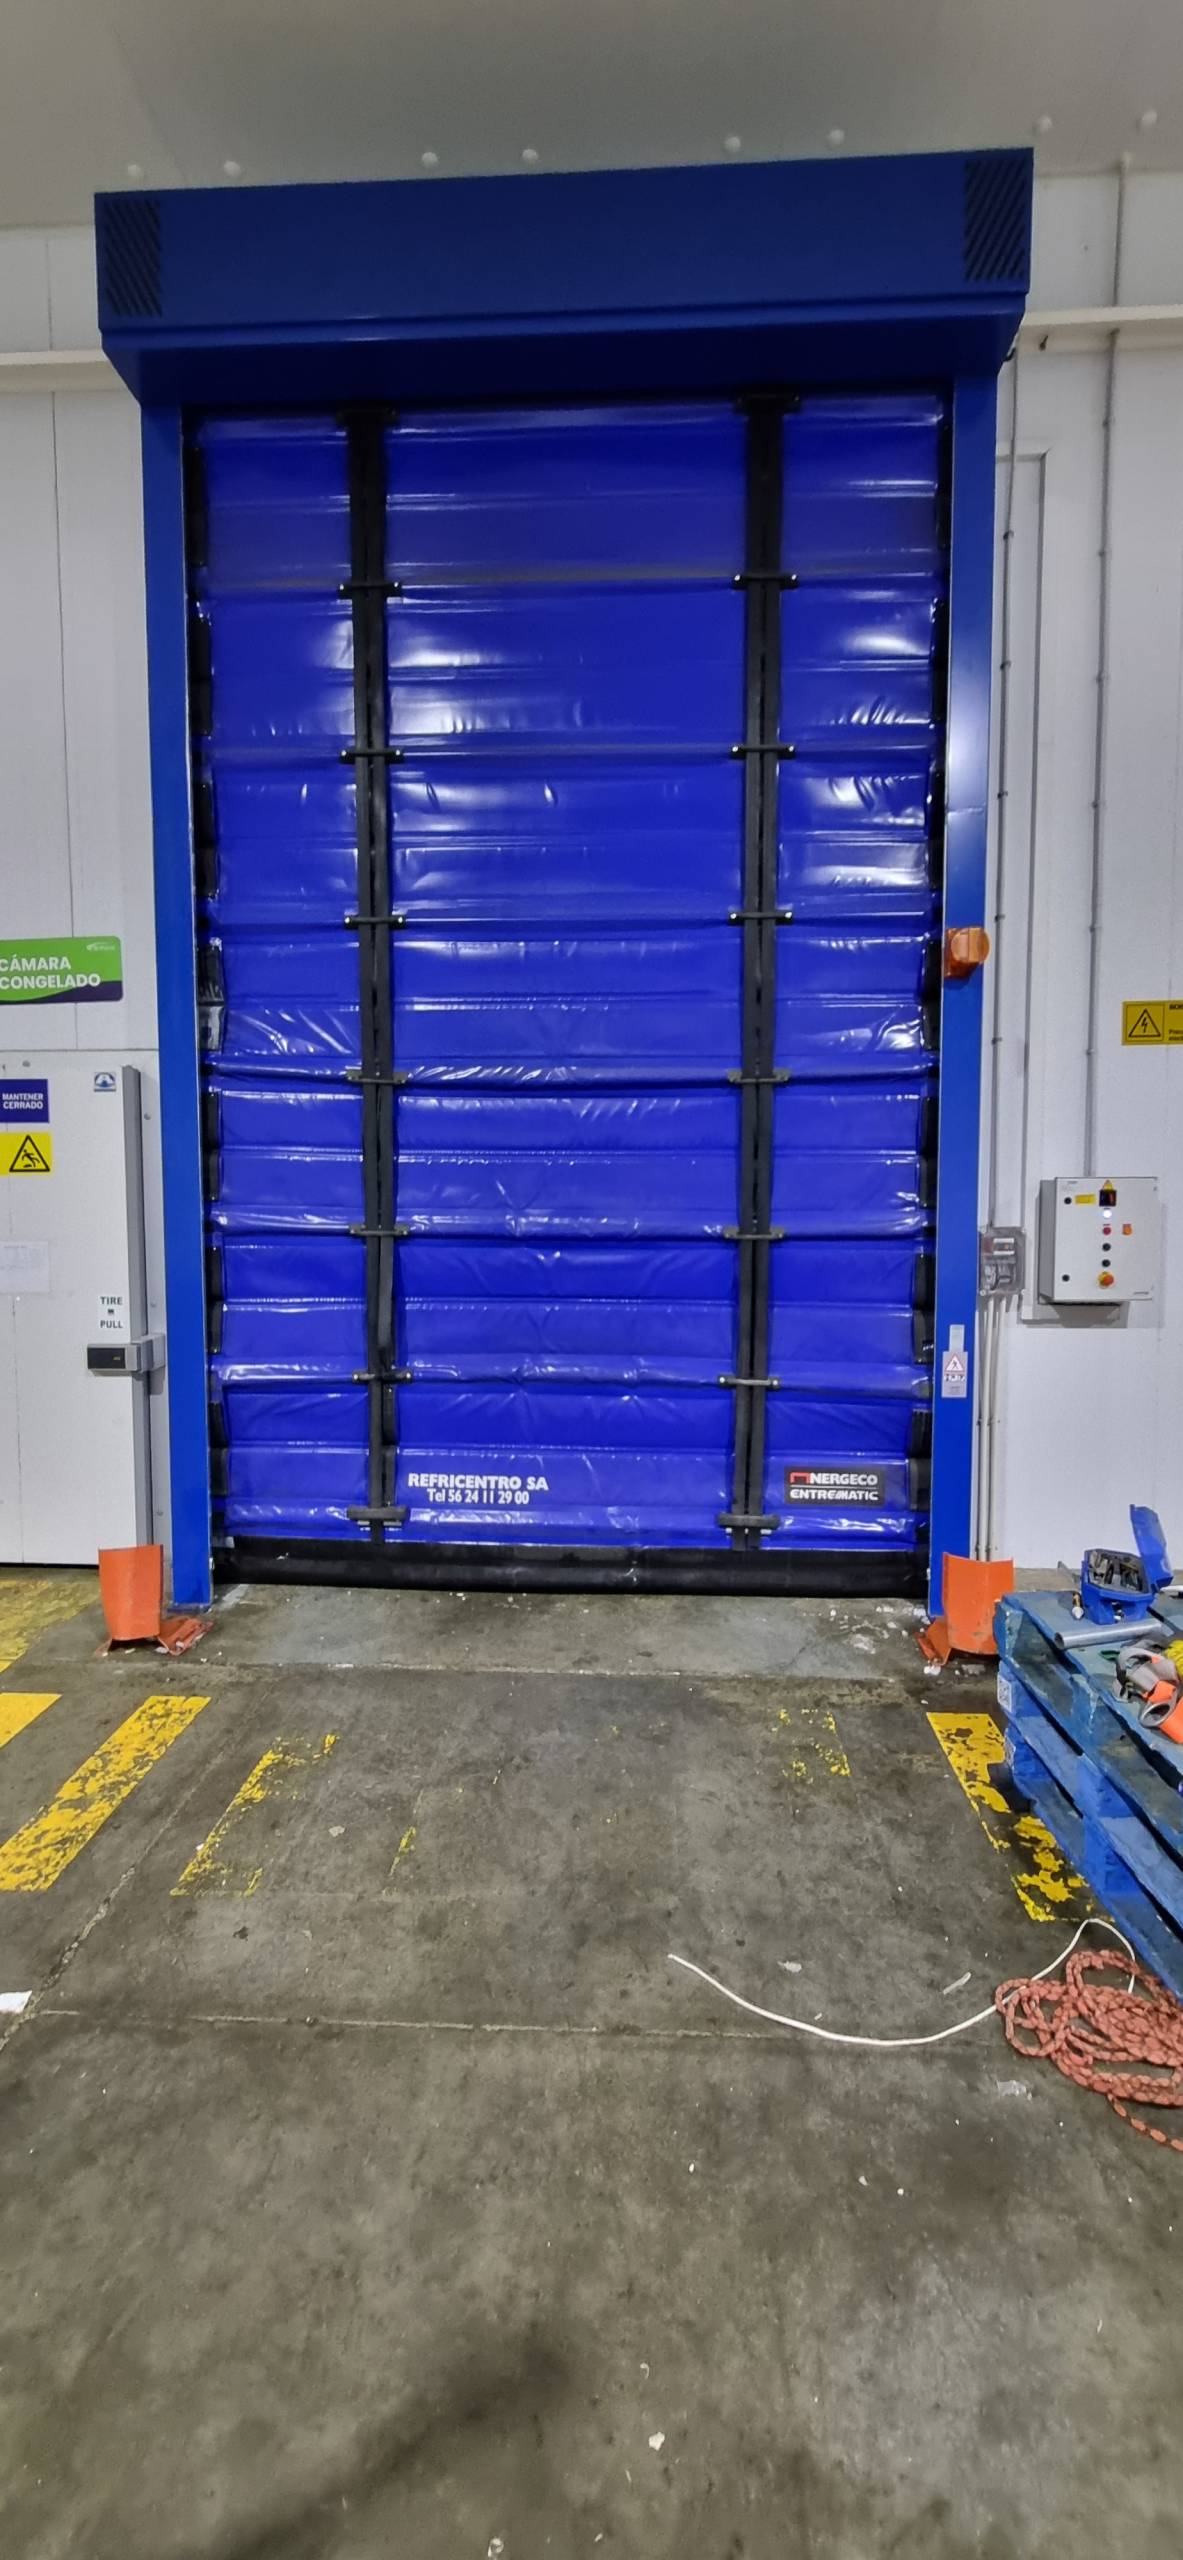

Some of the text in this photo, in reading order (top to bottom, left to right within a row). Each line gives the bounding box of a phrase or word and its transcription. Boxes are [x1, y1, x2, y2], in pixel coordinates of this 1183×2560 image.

[0, 954, 71, 971] CÁMARA
[0, 973, 101, 990] CONGELADO
[2, 1093, 44, 1101] MANTENER
[3, 1101, 43, 1110] CERRADO
[100, 1296, 122, 1305] TIRE
[100, 1320, 123, 1328] PULL
[408, 1473, 549, 1491] REFRICENTRO SA
[427, 1488, 530, 1505] Tel 56 24 11 29 00
[789, 1489, 879, 1501] ENTREMATIC
